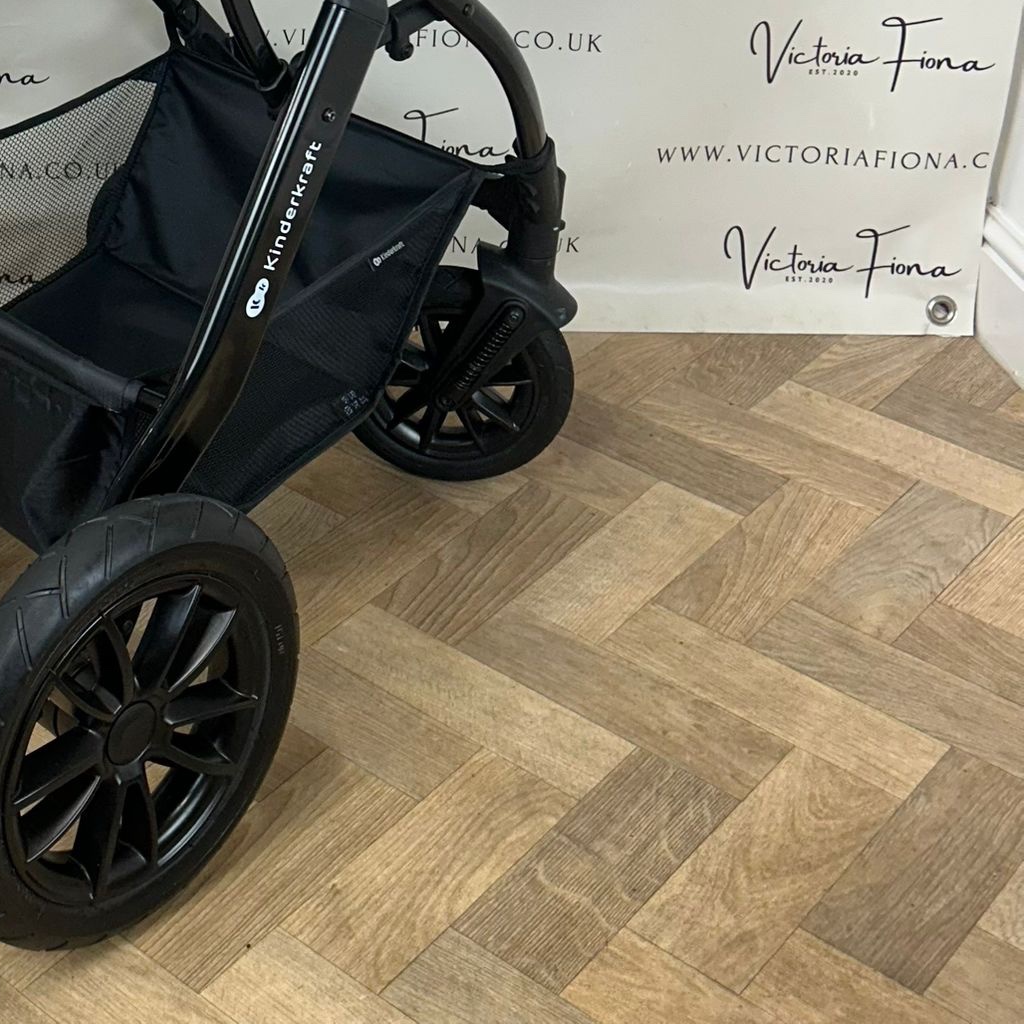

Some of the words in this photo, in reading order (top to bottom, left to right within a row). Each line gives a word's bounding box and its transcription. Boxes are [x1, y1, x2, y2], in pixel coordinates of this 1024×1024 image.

[750, 19, 879, 84] Victoria
[882, 16, 995, 92] Fiona
[809, 68, 858, 76] EST.2020
[263, 140, 322, 272] Kinderkraft
[724, 225, 854, 290] Victoria
[856, 224, 961, 299] Fiona
[785, 276, 834, 284] EST.2020
